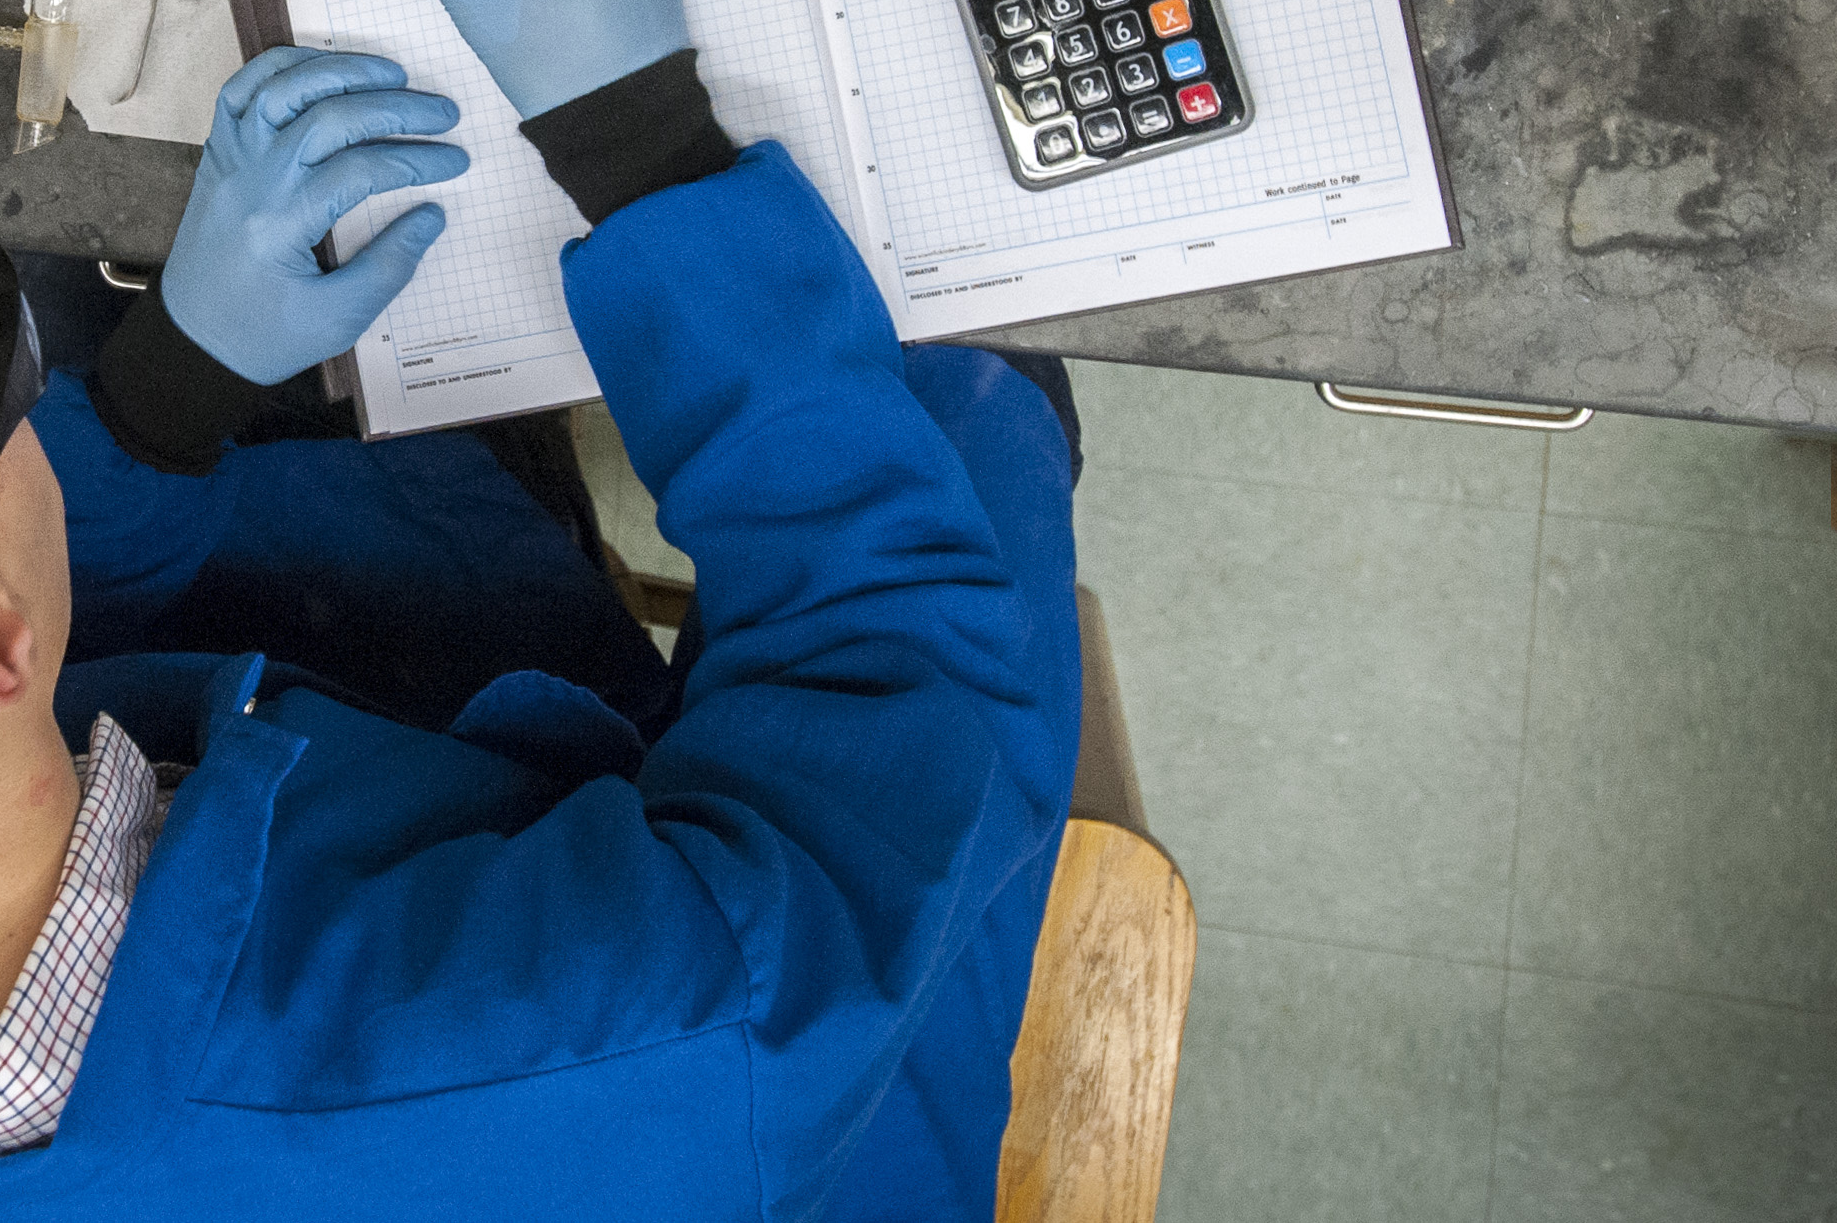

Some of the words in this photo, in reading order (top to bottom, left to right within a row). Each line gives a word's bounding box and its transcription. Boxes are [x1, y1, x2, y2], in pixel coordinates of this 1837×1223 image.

[835, 11, 845, 20] 20
[1006, 6, 1022, 27] 7
[324, 38, 332, 46] 15
[1023, 47, 1040, 68] 4
[1068, 34, 1085, 56] 5
[1115, 20, 1132, 42] 6
[1037, 91, 1050, 109] 1
[1080, 77, 1099, 99] 2
[1127, 62, 1145, 85] 3
[851, 88, 860, 97] 25
[866, 164, 876, 174] 30
[1264, 186, 1286, 198] Work
[1287, 178, 1328, 194] continued
[1329, 176, 1339, 187] to
[1340, 173, 1362, 186] Page
[1325, 192, 1343, 202] DATE
[1330, 217, 1348, 226] DATE
[882, 241, 892, 251] 35
[905, 265, 940, 278] SIGNATURE
[1120, 254, 1137, 264] DATE
[1187, 240, 1216, 251] WITNESS
[909, 290, 943, 302] DISCLOSED
[943, 287, 953, 296] TO
[954, 283, 969, 294] AND
[969, 278, 1013, 291] UNDERSTOOD
[1014, 274, 1024, 283] BY
[381, 334, 390, 343] 35
[402, 356, 434, 369] SIGNATURE
[406, 379, 438, 392] DISCLOSED
[438, 378, 447, 387] TO
[448, 374, 462, 385] AND
[463, 368, 503, 383] UNDERSTOOD
[503, 366, 513, 375] BY
